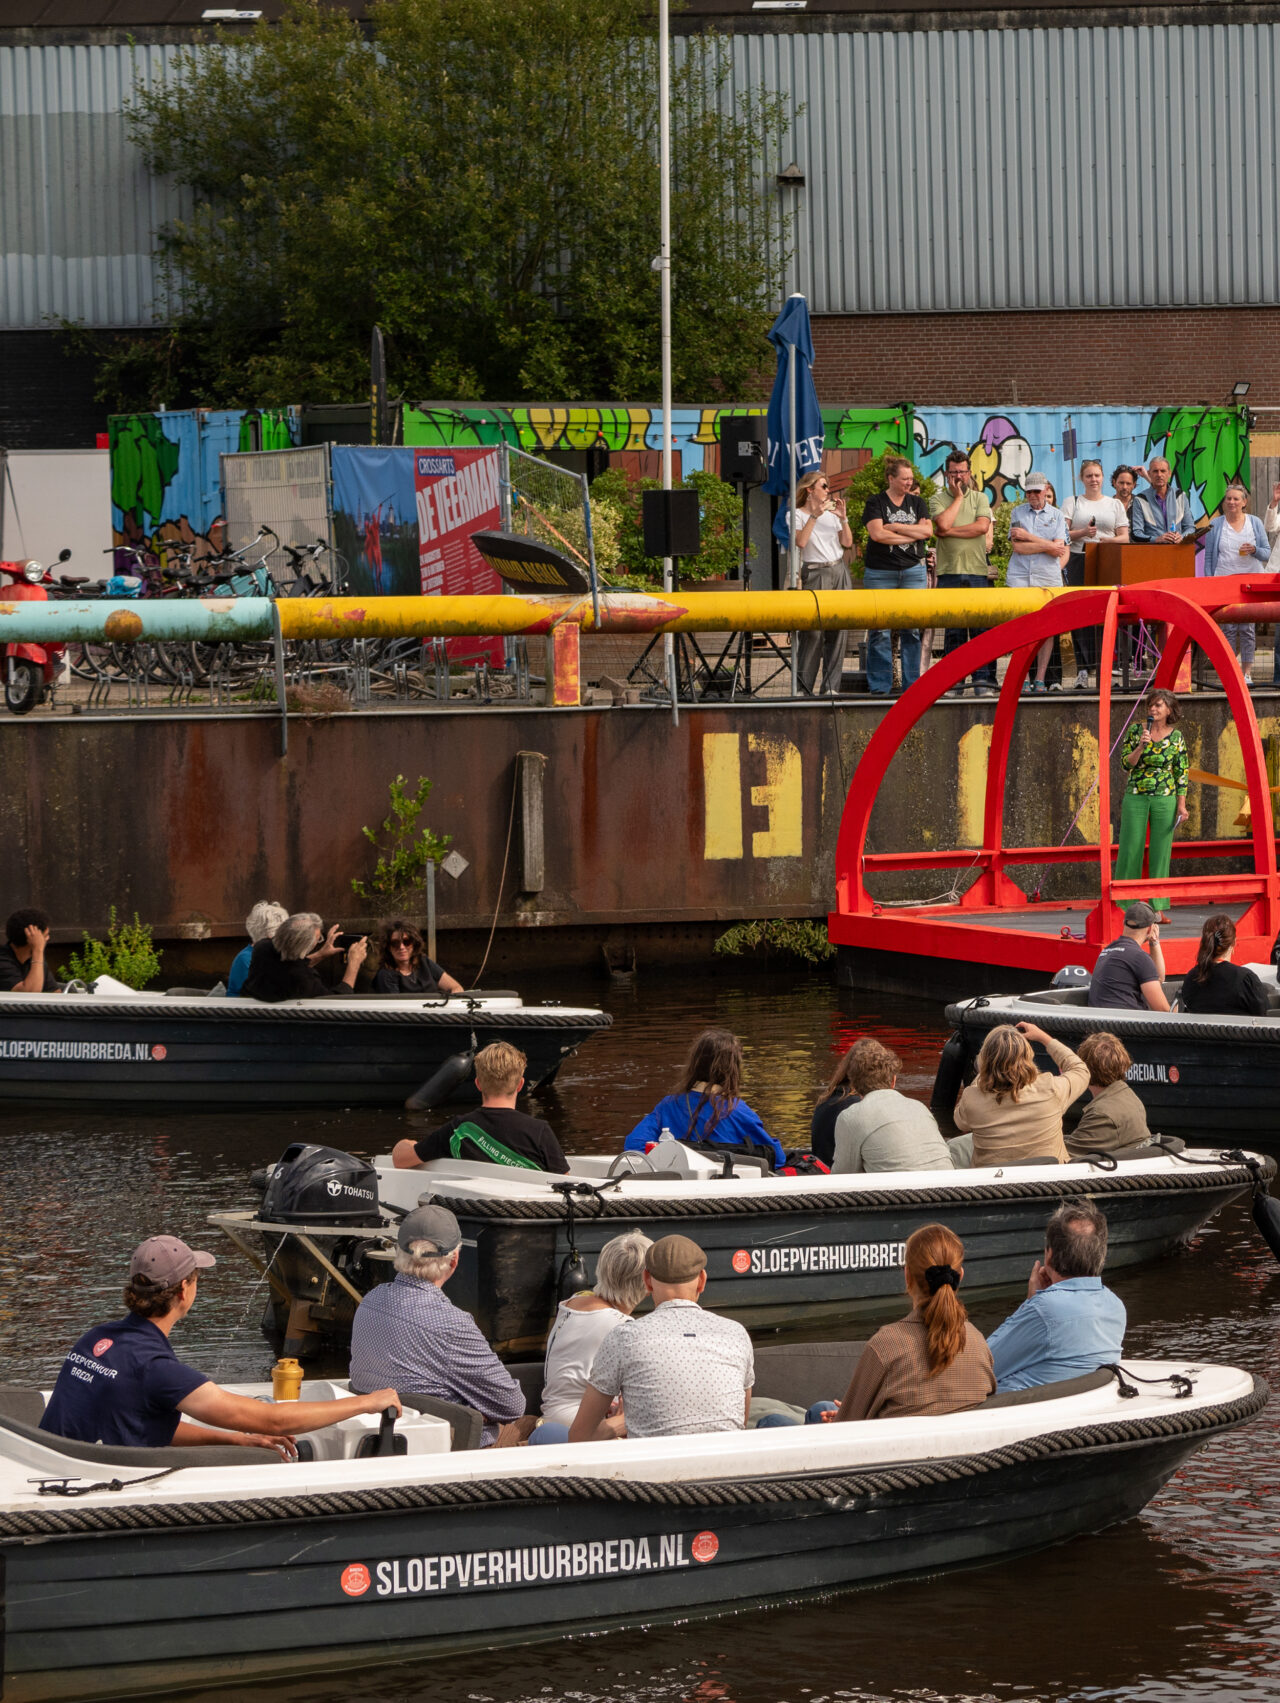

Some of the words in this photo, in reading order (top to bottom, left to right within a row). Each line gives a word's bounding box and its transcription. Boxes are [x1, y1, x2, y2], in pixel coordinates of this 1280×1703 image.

[418, 457, 456, 475] CROSSARTS
[416, 490, 438, 545] DE
[432, 450, 500, 536] VEERMAN
[1062, 966, 1088, 977] 10
[1125, 1062, 1169, 1084] BREDA.NL
[477, 1136, 499, 1157] FILLING
[274, 1167, 285, 1180] 6
[343, 1185, 374, 1200] TOHATSU
[70, 1366, 95, 1384] BREDA
[376, 1534, 689, 1596] SLOEPVERHUURBREDA.NL
